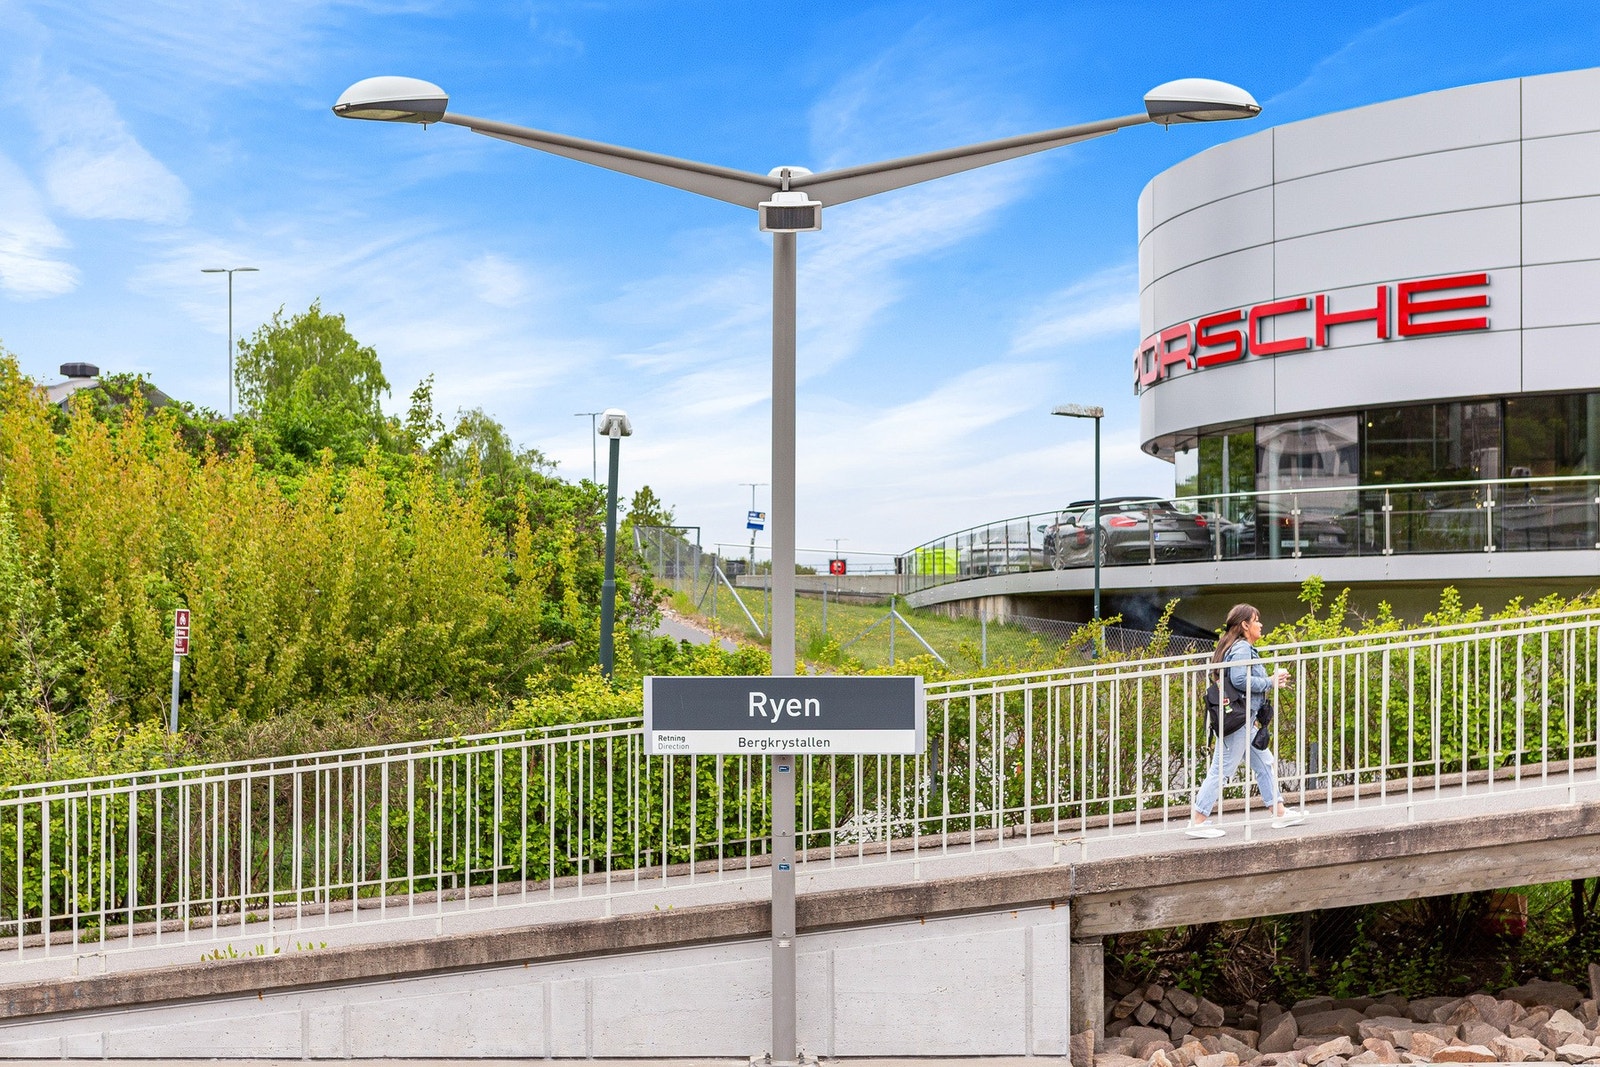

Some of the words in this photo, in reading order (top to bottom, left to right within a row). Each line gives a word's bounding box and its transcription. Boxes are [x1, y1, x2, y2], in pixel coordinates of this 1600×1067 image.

[749, 691, 821, 723] Ryen
[658, 734, 686, 743] Retning
[738, 736, 831, 750] Bergkrystallen
